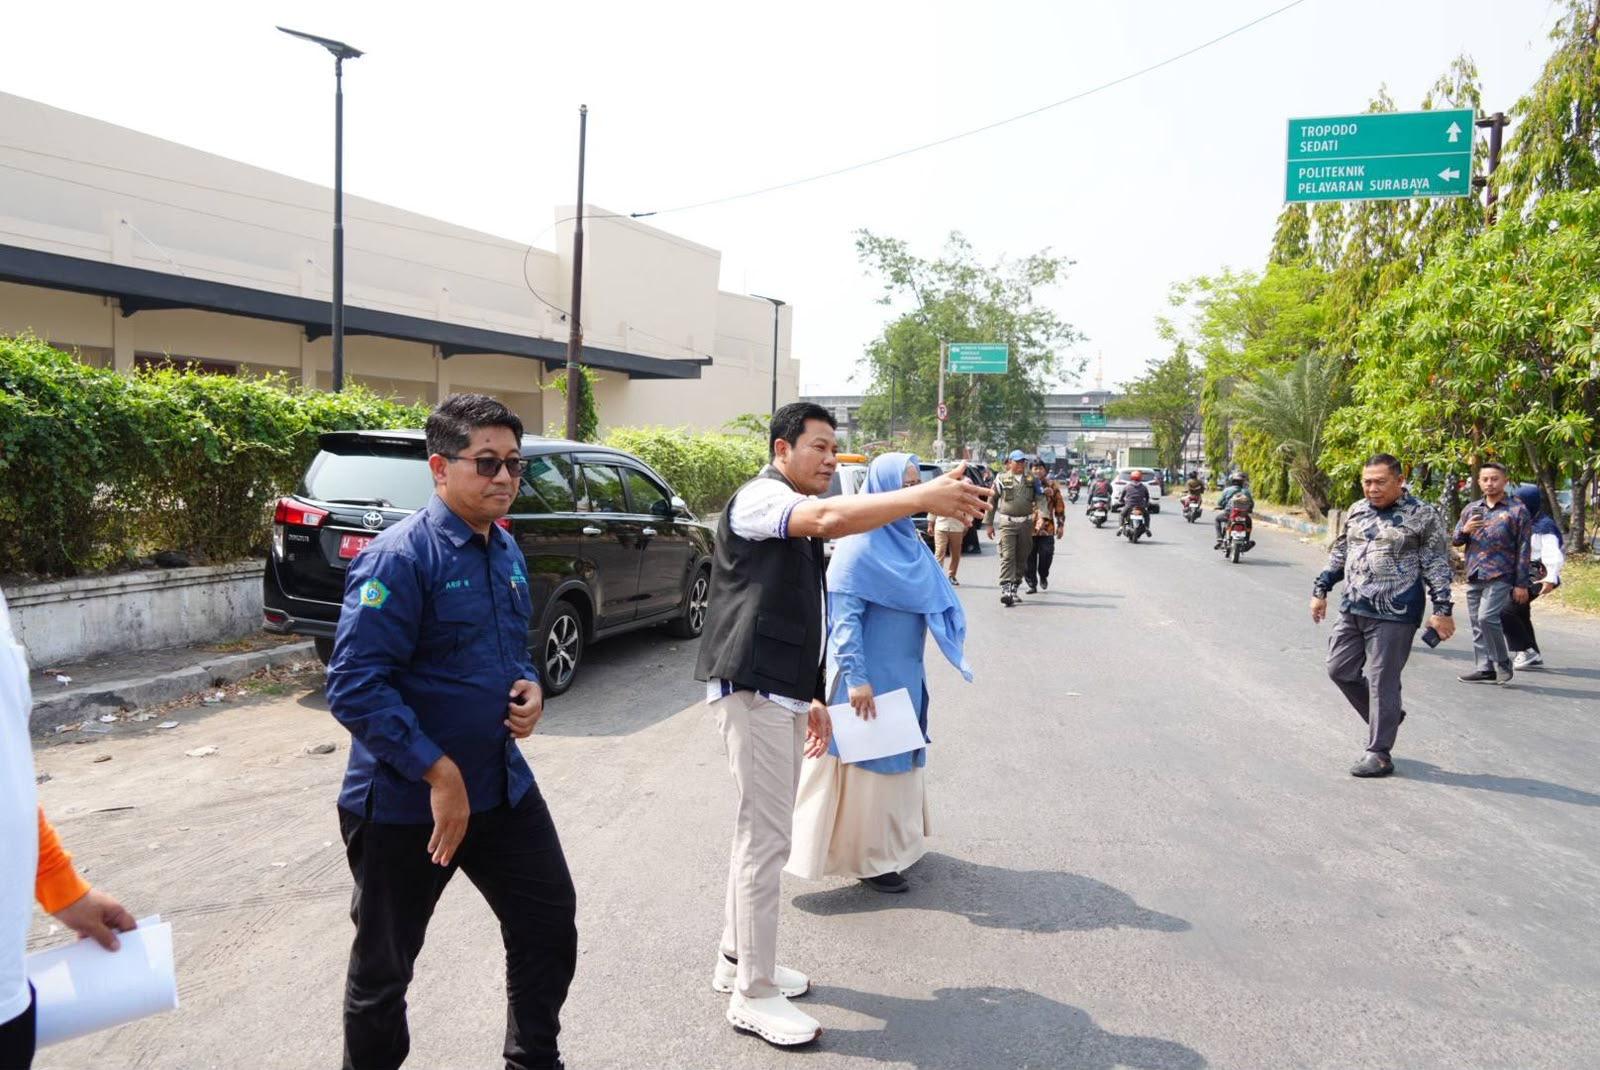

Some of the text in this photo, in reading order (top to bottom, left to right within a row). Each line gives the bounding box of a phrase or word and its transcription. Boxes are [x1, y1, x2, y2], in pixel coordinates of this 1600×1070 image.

[1301, 123, 1357, 137] TROPODO
[1300, 140, 1338, 152] SEDATI
[1299, 165, 1365, 179] POLITEKNIK
[1298, 177, 1430, 194] PELAYARAN SURABAYA
